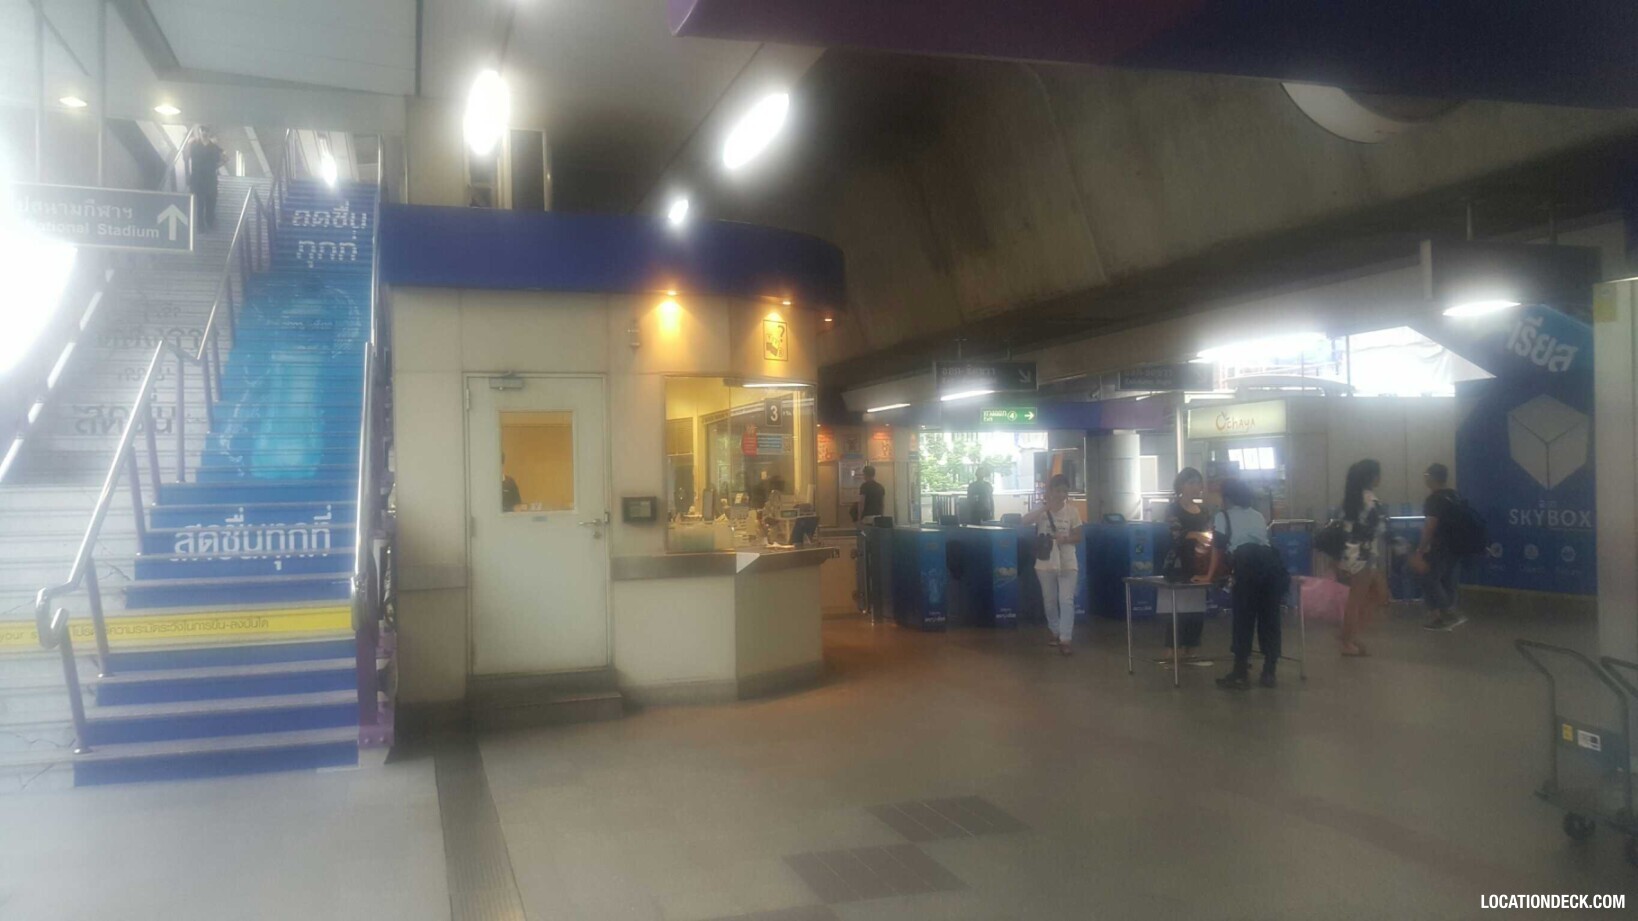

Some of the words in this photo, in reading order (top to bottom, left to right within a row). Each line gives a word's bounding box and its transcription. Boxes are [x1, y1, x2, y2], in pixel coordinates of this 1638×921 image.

[97, 223, 160, 239] Stadium
[770, 405, 778, 422] 3
[1508, 508, 1592, 528] SKYBOX
[169, 504, 332, 571] สดชื่นทุกที่
